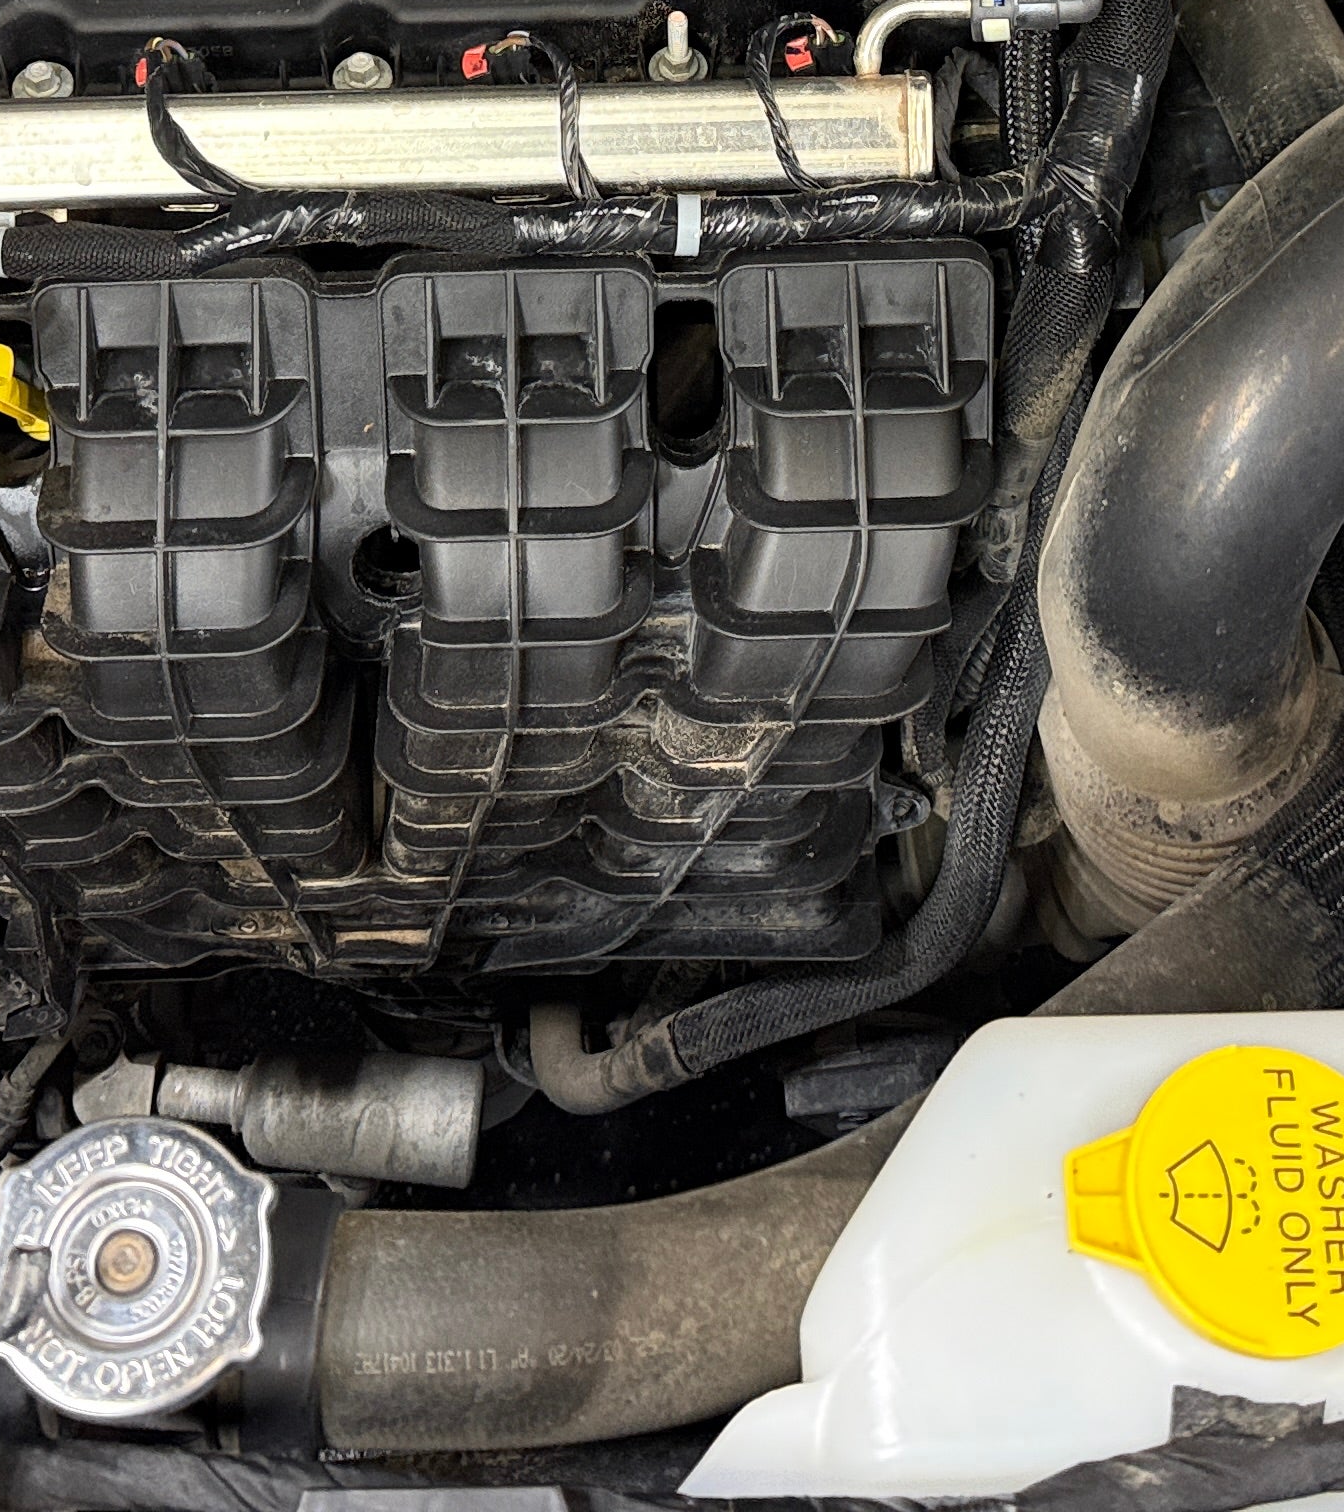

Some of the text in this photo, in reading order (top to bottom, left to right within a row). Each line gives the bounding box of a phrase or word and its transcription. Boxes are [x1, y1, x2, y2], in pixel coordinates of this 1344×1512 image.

[33, 1134, 236, 1206] KEEP TIGHT
[1262, 1067, 1321, 1329] FLUID ONLY
[93, 1337, 194, 1395] OPEN
